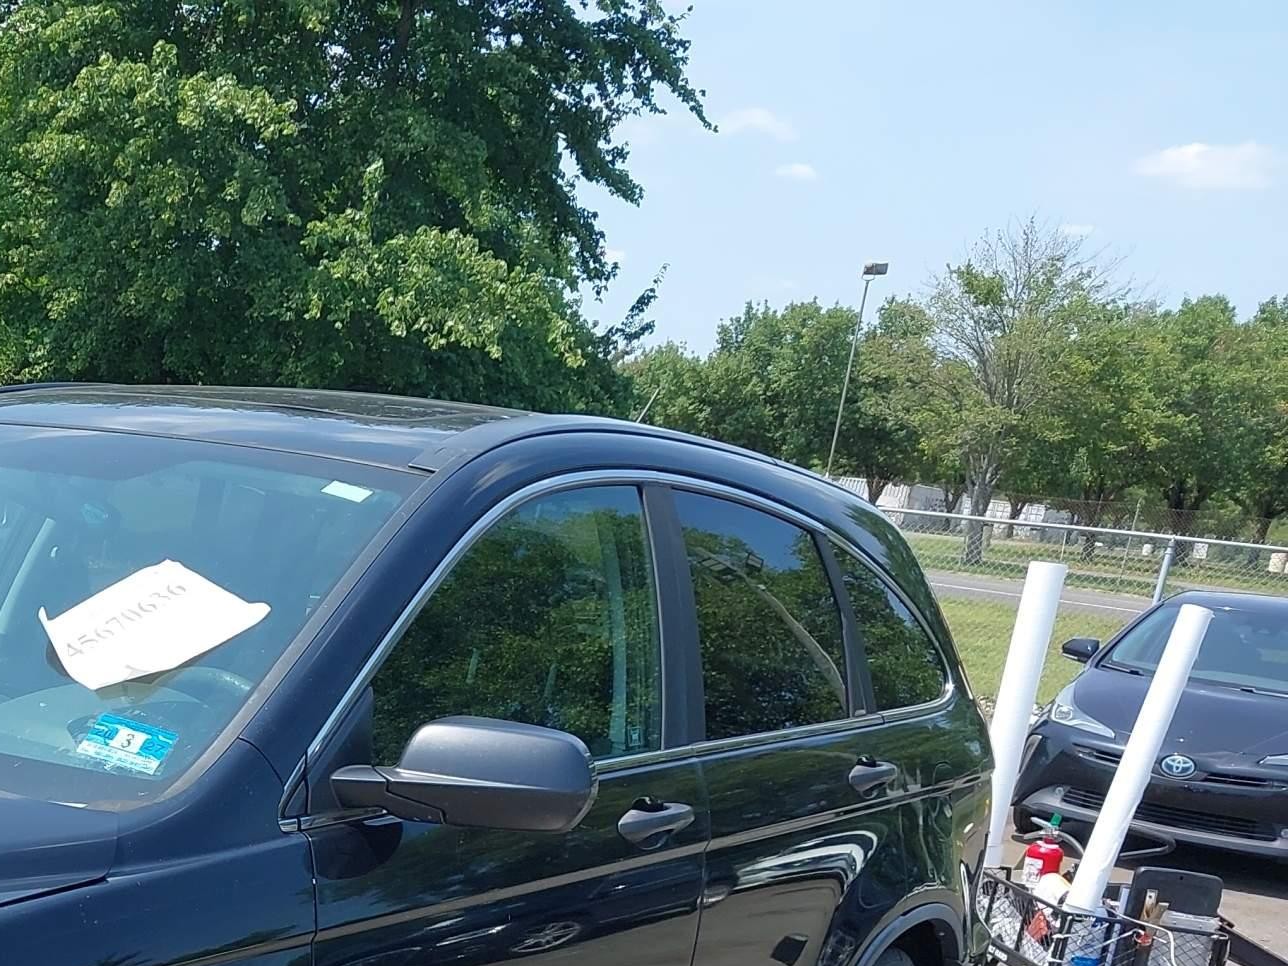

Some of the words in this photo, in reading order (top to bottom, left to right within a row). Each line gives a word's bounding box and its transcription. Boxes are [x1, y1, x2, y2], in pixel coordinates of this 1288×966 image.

[67, 584, 187, 658] 45670636
[120, 733, 136, 749] 3
[144, 741, 166, 753] 27
